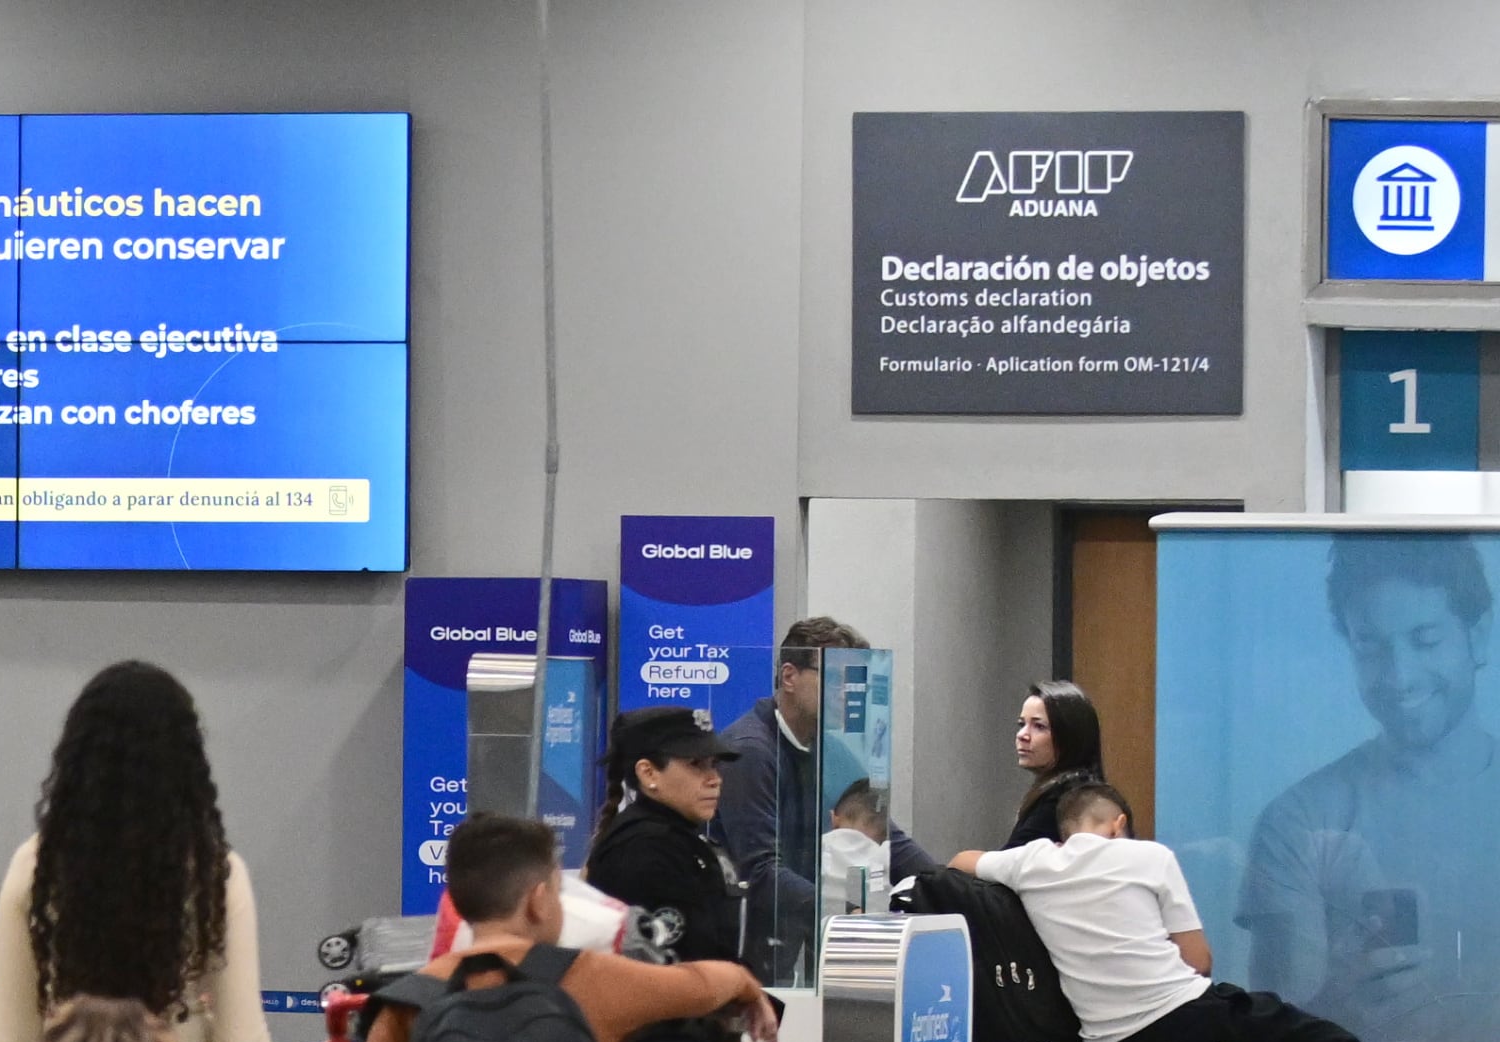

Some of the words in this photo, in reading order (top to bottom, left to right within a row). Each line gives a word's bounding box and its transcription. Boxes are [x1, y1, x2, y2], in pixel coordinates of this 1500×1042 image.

[955, 150, 1134, 203] AFIP
[154, 187, 262, 217] hacen
[1008, 200, 1099, 218] ADUANA
[113, 237, 286, 260] conservar
[881, 255, 1052, 281] Declaración
[1057, 255, 1094, 281] de
[1100, 255, 1211, 287] objetos
[881, 288, 969, 307] Customs
[975, 287, 1092, 307] declaration
[881, 315, 995, 337] Declaração
[1000, 314, 1131, 337] alfandegária
[5, 331, 48, 354] en
[54, 324, 132, 354] clase
[139, 324, 279, 358] ejecutiva
[879, 356, 973, 372] Formulario
[986, 356, 1074, 376] Aplication
[1078, 356, 1119, 372] form
[1123, 356, 1210, 373] OM-121/4
[1389, 369, 1431, 434] 1
[60, 405, 116, 425] con
[124, 399, 256, 425] choferes
[22, 490, 107, 511] obligando
[112, 495, 121, 506] a
[127, 495, 174, 511] parar
[179, 491, 260, 506] denunciá
[265, 491, 280, 506] al
[286, 492, 313, 507] 134
[641, 543, 705, 560] Global
[709, 544, 753, 560] Blue
[430, 626, 491, 642] Global
[495, 627, 537, 642] Blue
[648, 624, 684, 640] Get
[648, 645, 694, 662] your
[695, 644, 730, 660] Tax
[649, 664, 718, 681] Refund
[647, 683, 692, 699] here
[430, 776, 468, 793] Get
[429, 801, 468, 818] you
[429, 819, 459, 837] Ta
[428, 867, 449, 885] he
